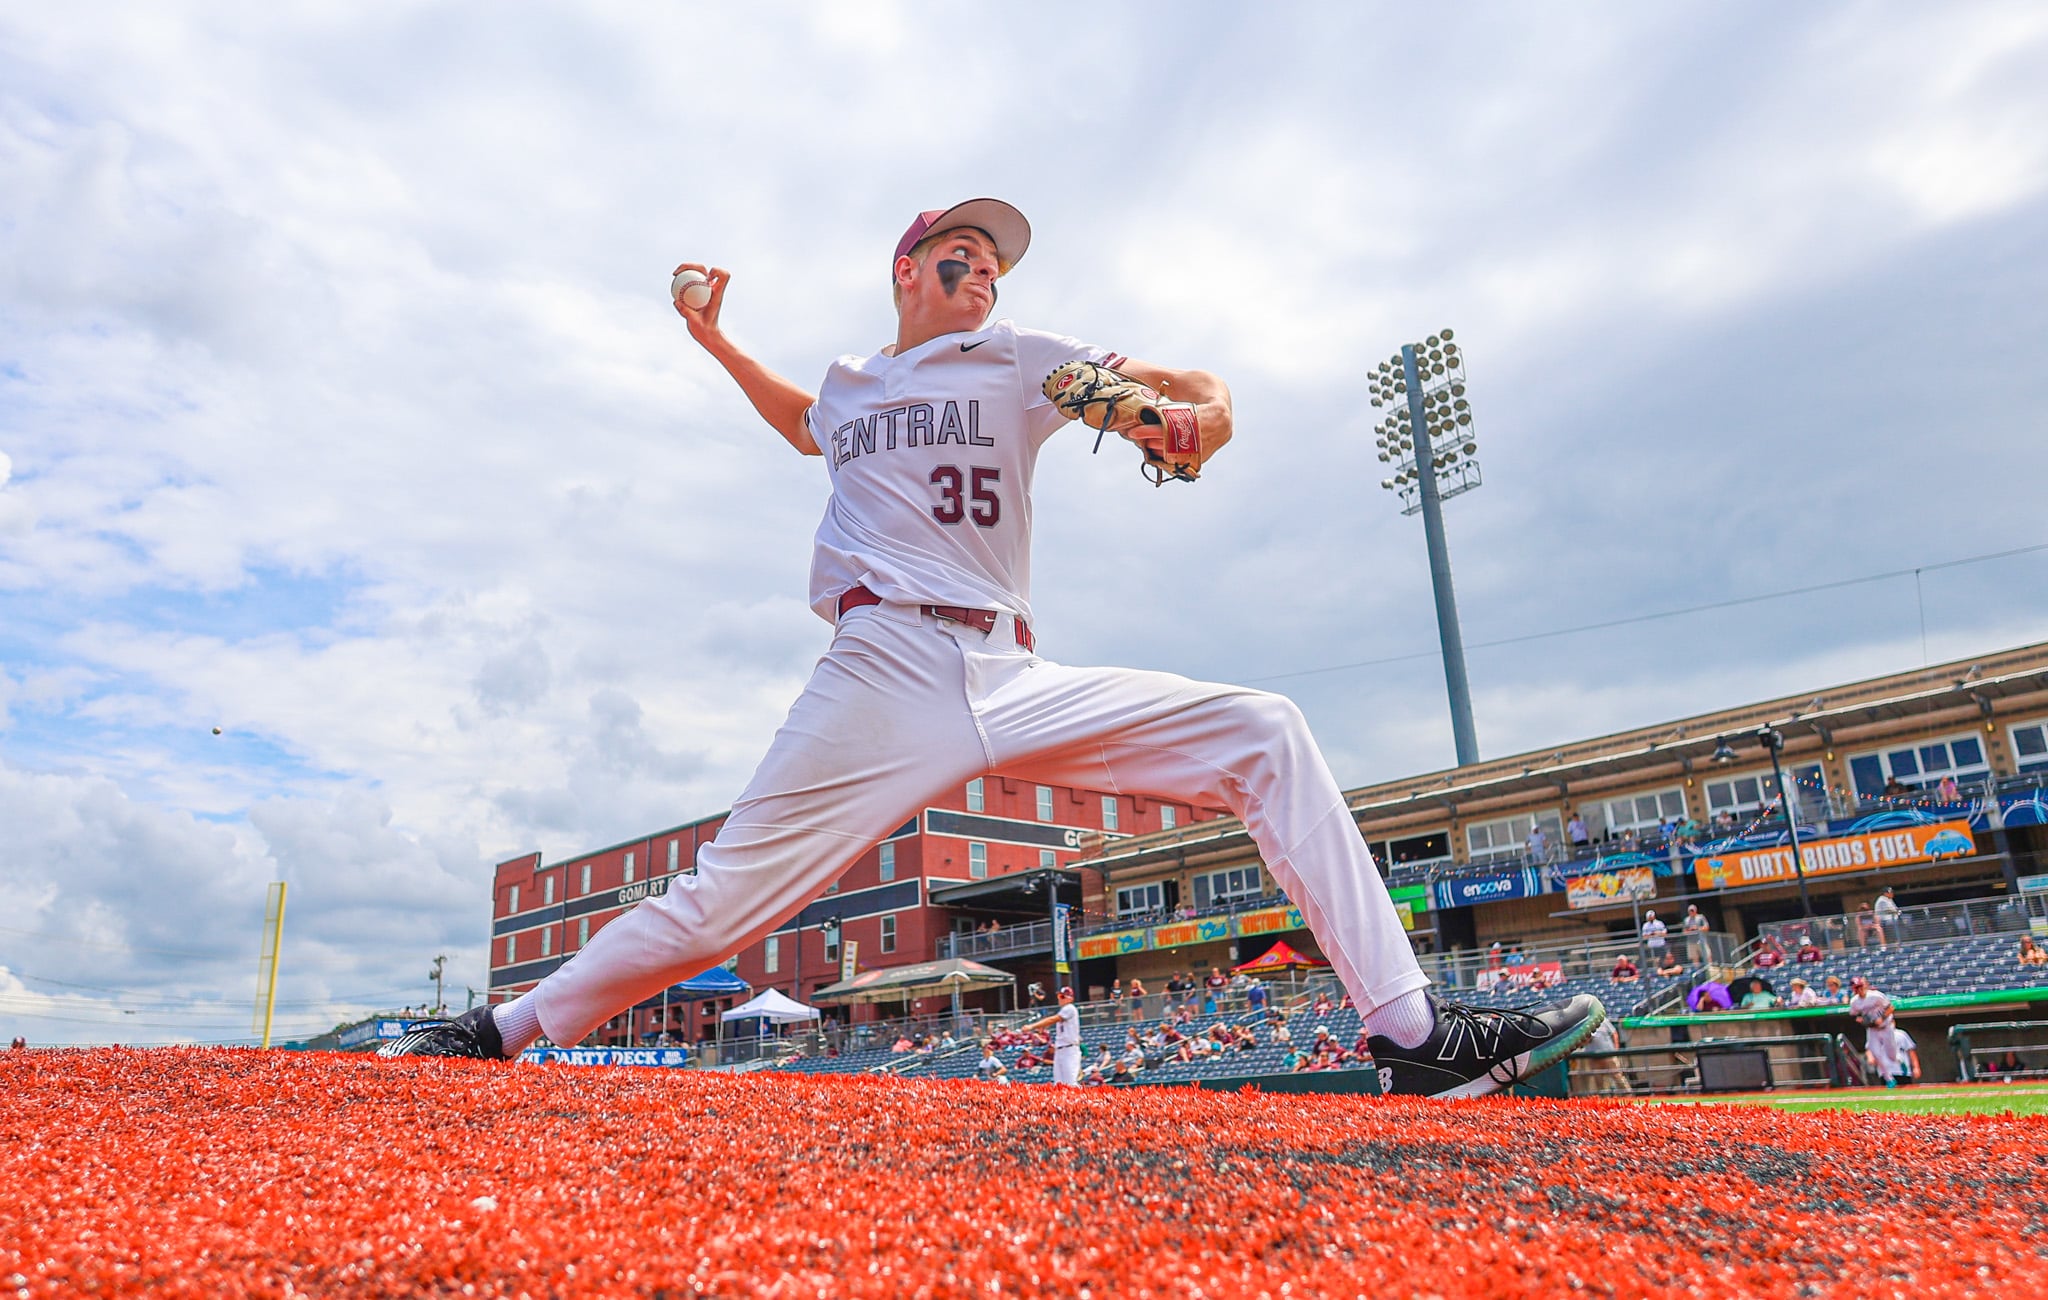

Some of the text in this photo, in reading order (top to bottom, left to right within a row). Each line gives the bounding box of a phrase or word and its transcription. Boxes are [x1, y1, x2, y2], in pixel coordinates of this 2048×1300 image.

[831, 400, 994, 472] CENTRAL
[928, 464, 1001, 529] 35
[1739, 832, 1921, 881] DIRTY BIRDS FUEL
[1463, 879, 1512, 897] encova
[611, 1050, 658, 1066] DECK
